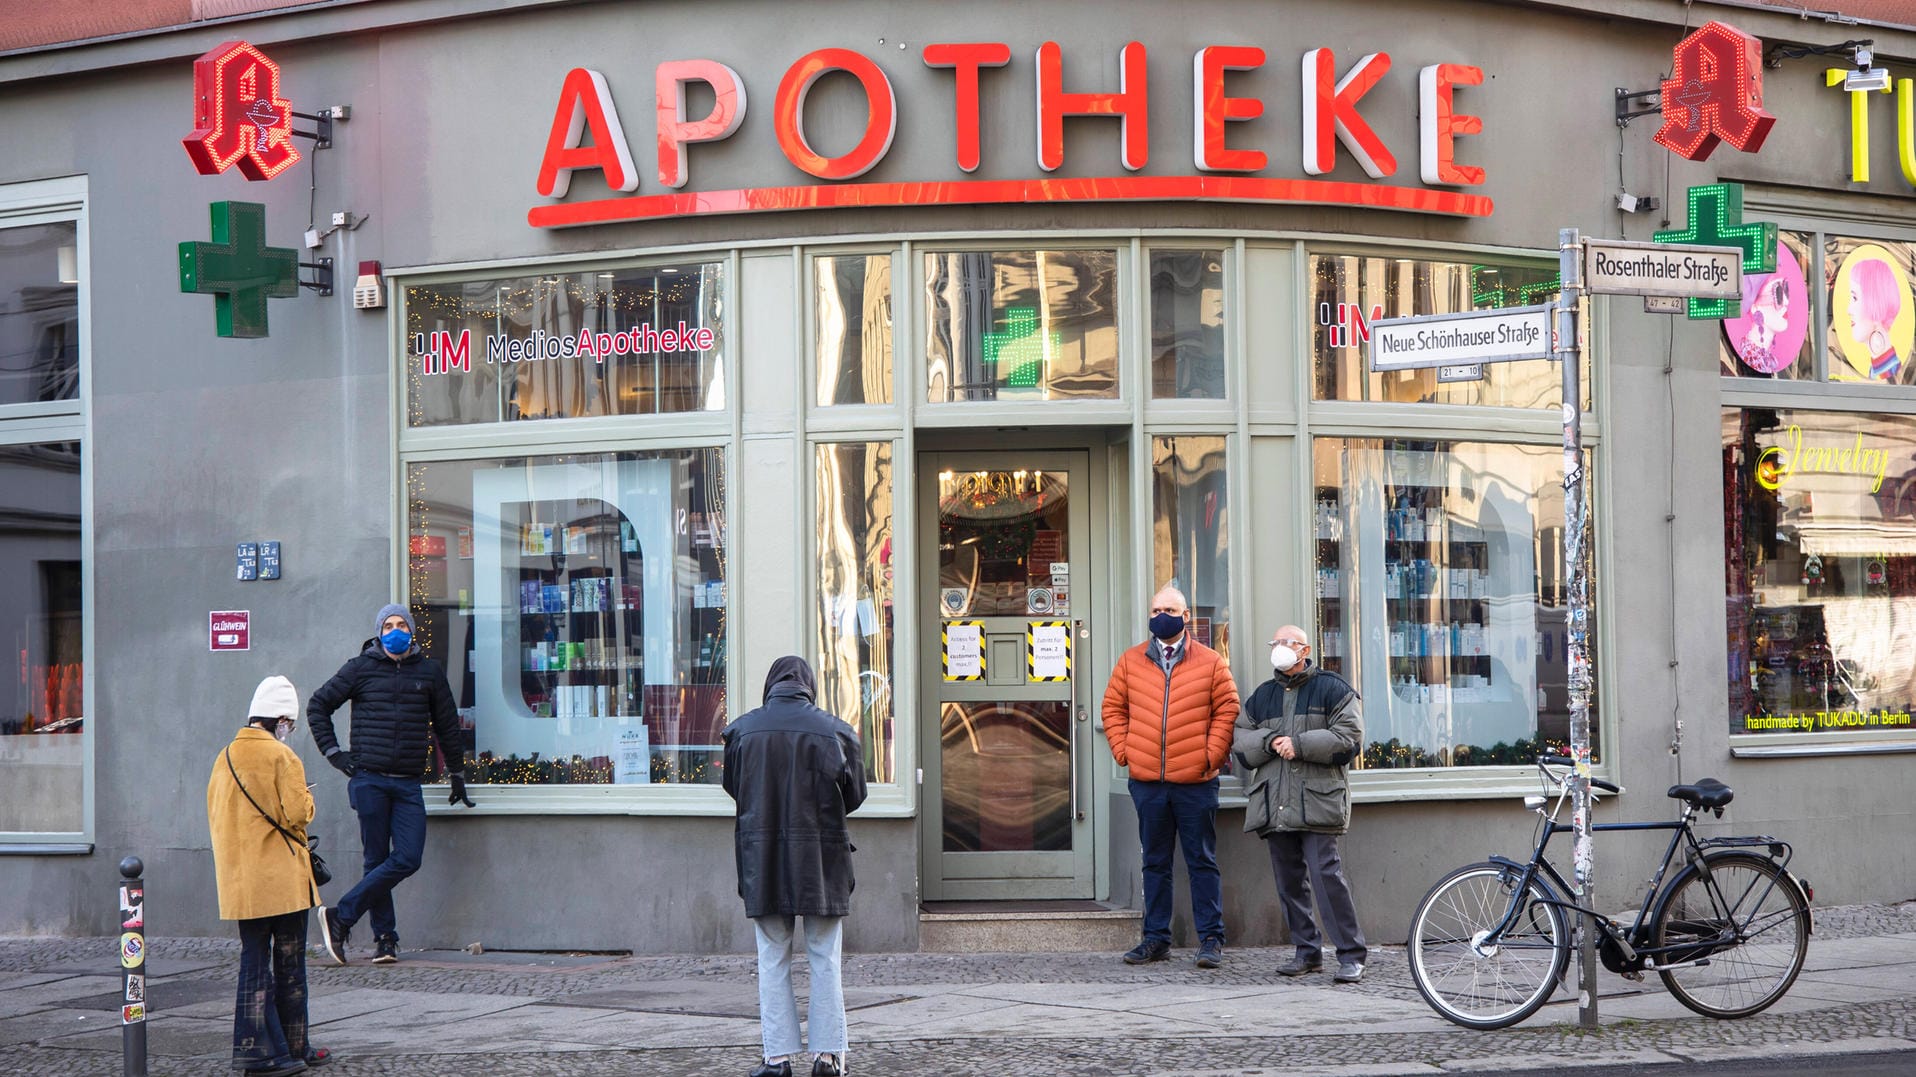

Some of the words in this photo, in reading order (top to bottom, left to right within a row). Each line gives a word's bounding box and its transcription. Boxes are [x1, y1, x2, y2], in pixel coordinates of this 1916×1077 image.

[537, 41, 1486, 198] APOTHEKE
[1596, 252, 1682, 279] Rosenthaler
[1684, 257, 1728, 286] Straße
[487, 321, 714, 363] MediosApotheke
[1383, 334, 1415, 353] Neue
[1417, 330, 1495, 351] Schönhauser
[1498, 321, 1539, 346] Straße
[1470, 367, 1478, 375] 10
[1755, 424, 1889, 493] Jewelry
[213, 620, 247, 631] GLÜHWEIN
[1746, 713, 1799, 729] handmade
[1802, 713, 1815, 732] by
[1816, 711, 1868, 727] TUKADU
[1869, 711, 1879, 724] in
[1881, 710, 1911, 725] Berlin
